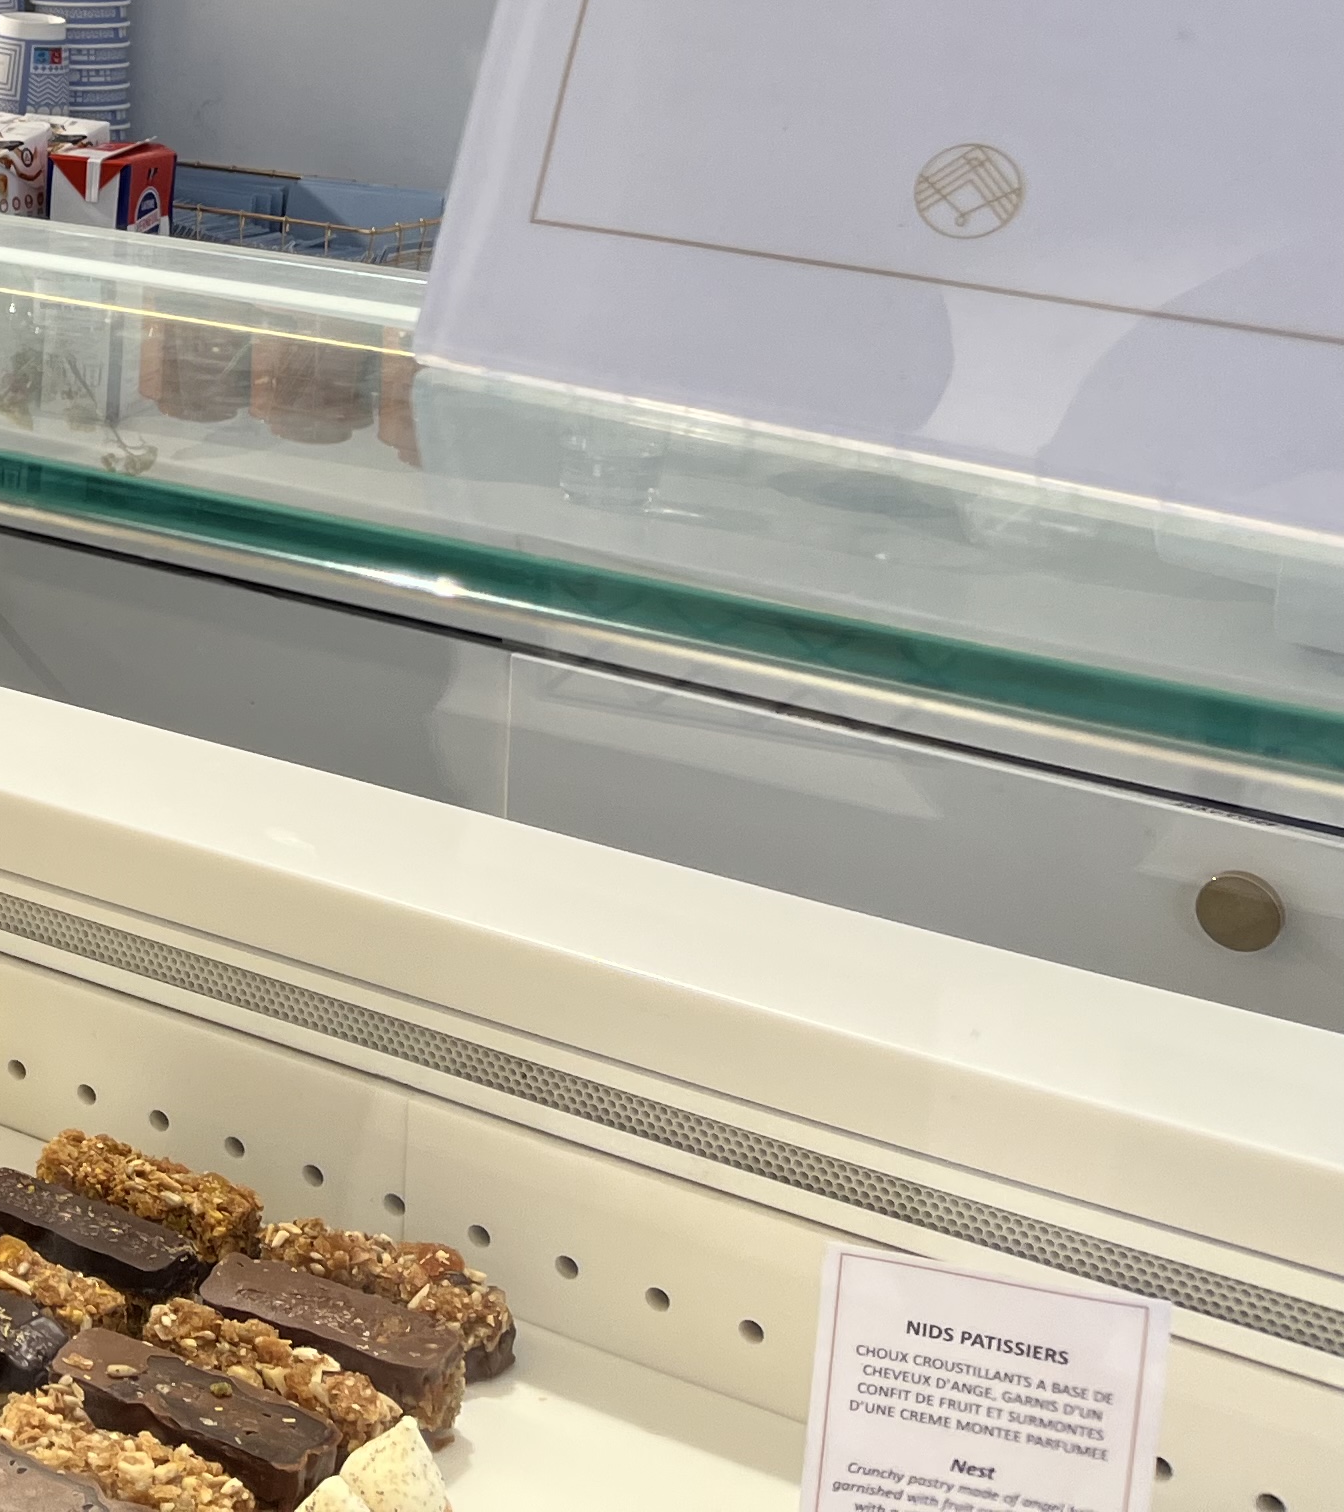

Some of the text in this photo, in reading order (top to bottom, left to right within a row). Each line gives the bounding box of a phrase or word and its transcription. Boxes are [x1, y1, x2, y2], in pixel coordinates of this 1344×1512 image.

[906, 1320, 1069, 1365] NIDS PATISSIERS
[856, 1344, 1114, 1405] CHOUX CROUSTILLANTS A BASE DE
[863, 1364, 931, 1387] CHEVEUX
[1002, 1391, 1059, 1413] GARNIS
[950, 1458, 997, 1480] Nest
